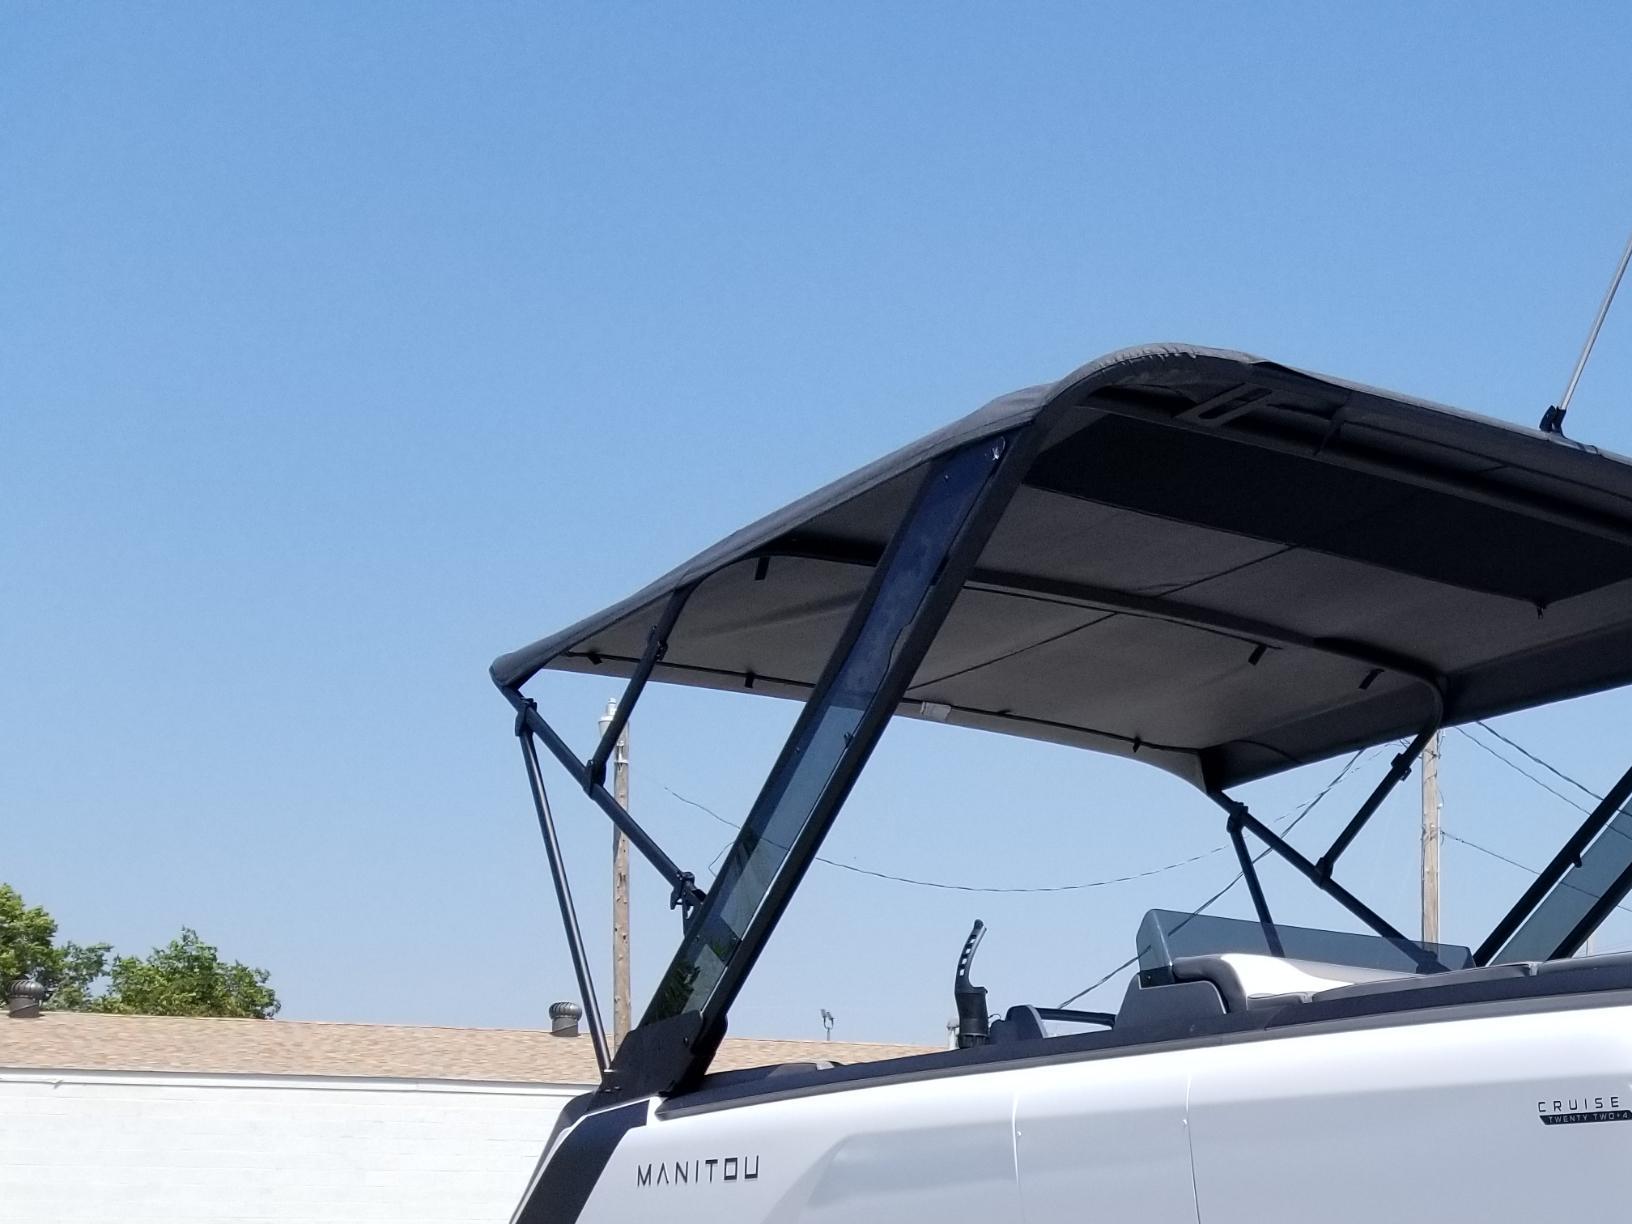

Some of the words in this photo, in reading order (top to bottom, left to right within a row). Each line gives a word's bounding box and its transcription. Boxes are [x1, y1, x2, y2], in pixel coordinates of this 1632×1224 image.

[1538, 1096, 1620, 1112] CRUISE
[1548, 1113, 1588, 1124] TWENTY
[637, 1155, 760, 1187] MANITOU
